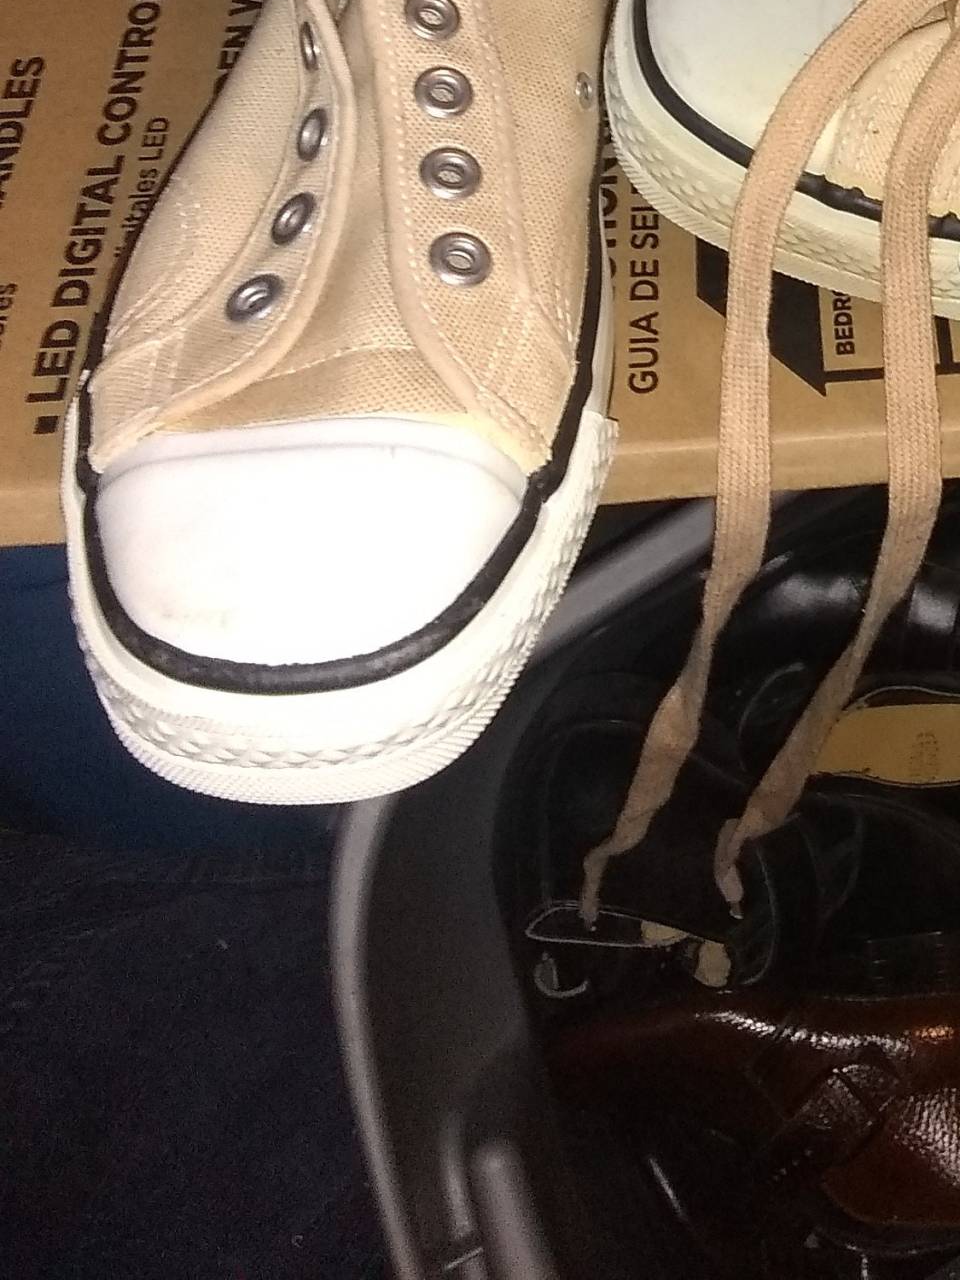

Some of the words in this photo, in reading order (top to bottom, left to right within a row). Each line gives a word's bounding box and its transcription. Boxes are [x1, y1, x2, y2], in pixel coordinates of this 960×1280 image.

[138, 117, 169, 161] LED
[52, 154, 125, 308] DIGITAL
[629, 259, 660, 302] DE
[25, 319, 80, 403] LED
[628, 312, 660, 395] GUIA
